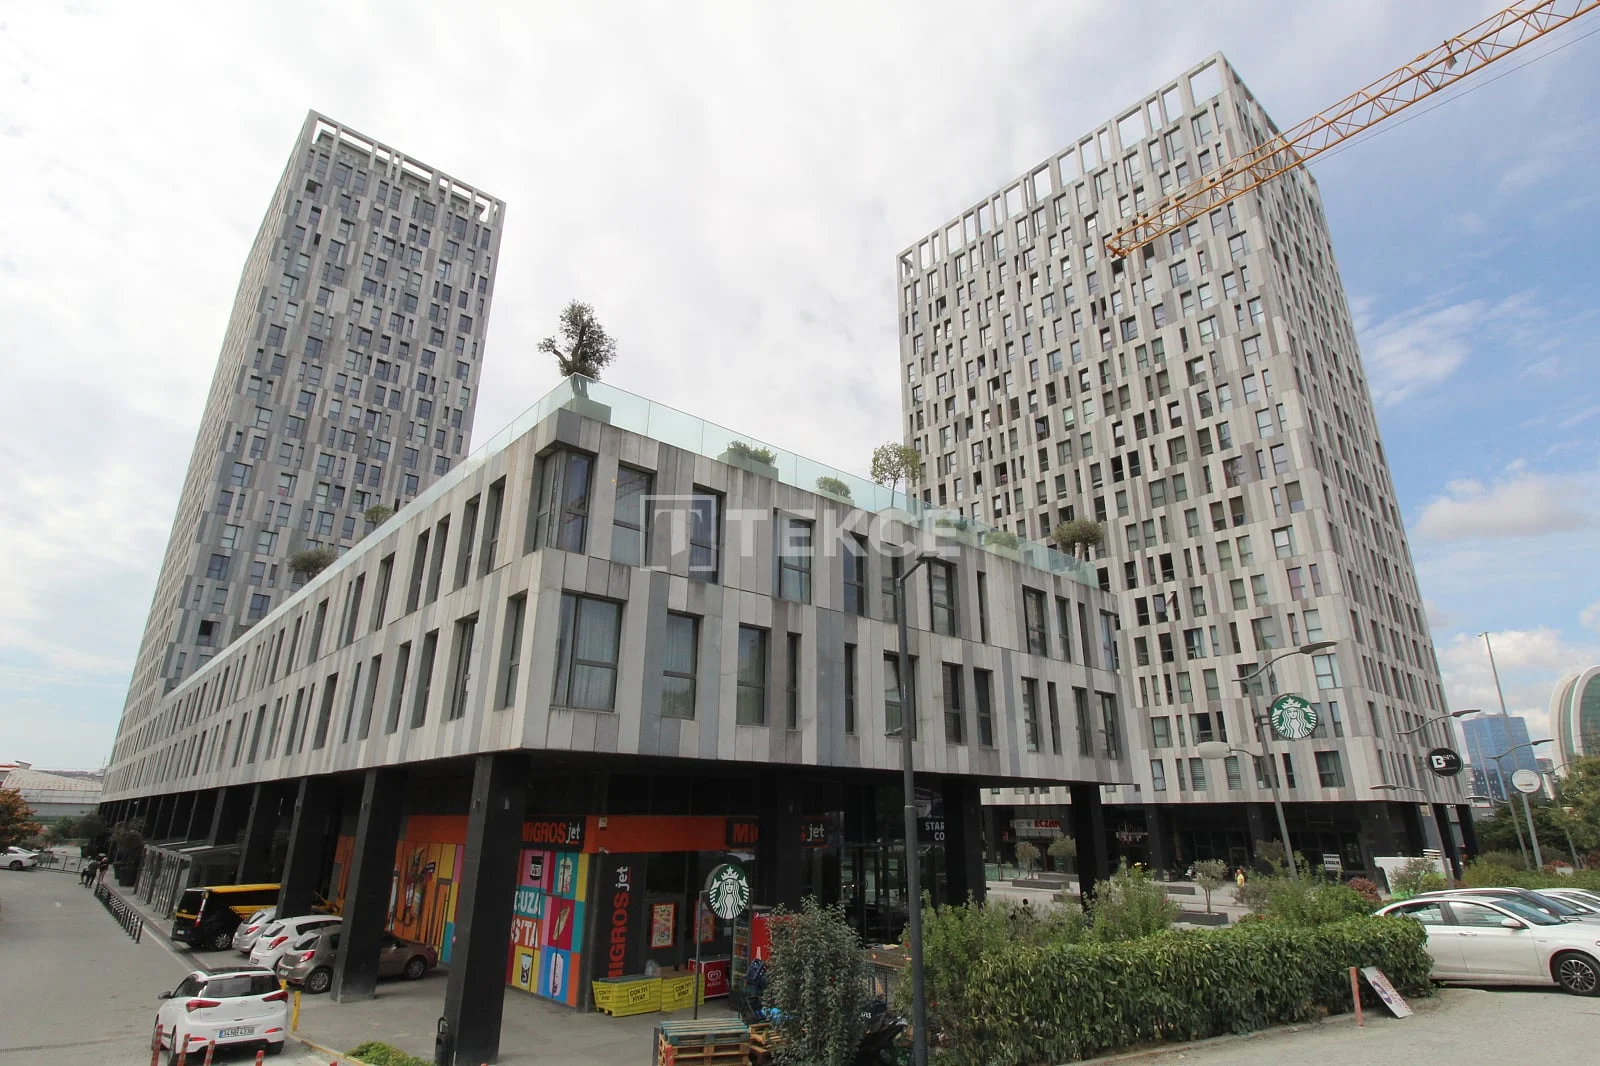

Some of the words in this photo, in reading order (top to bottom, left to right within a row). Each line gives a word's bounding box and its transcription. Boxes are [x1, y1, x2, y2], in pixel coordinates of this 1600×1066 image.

[565, 821, 581, 844] jet
[806, 823, 825, 842] jet
[615, 865, 630, 892] jet
